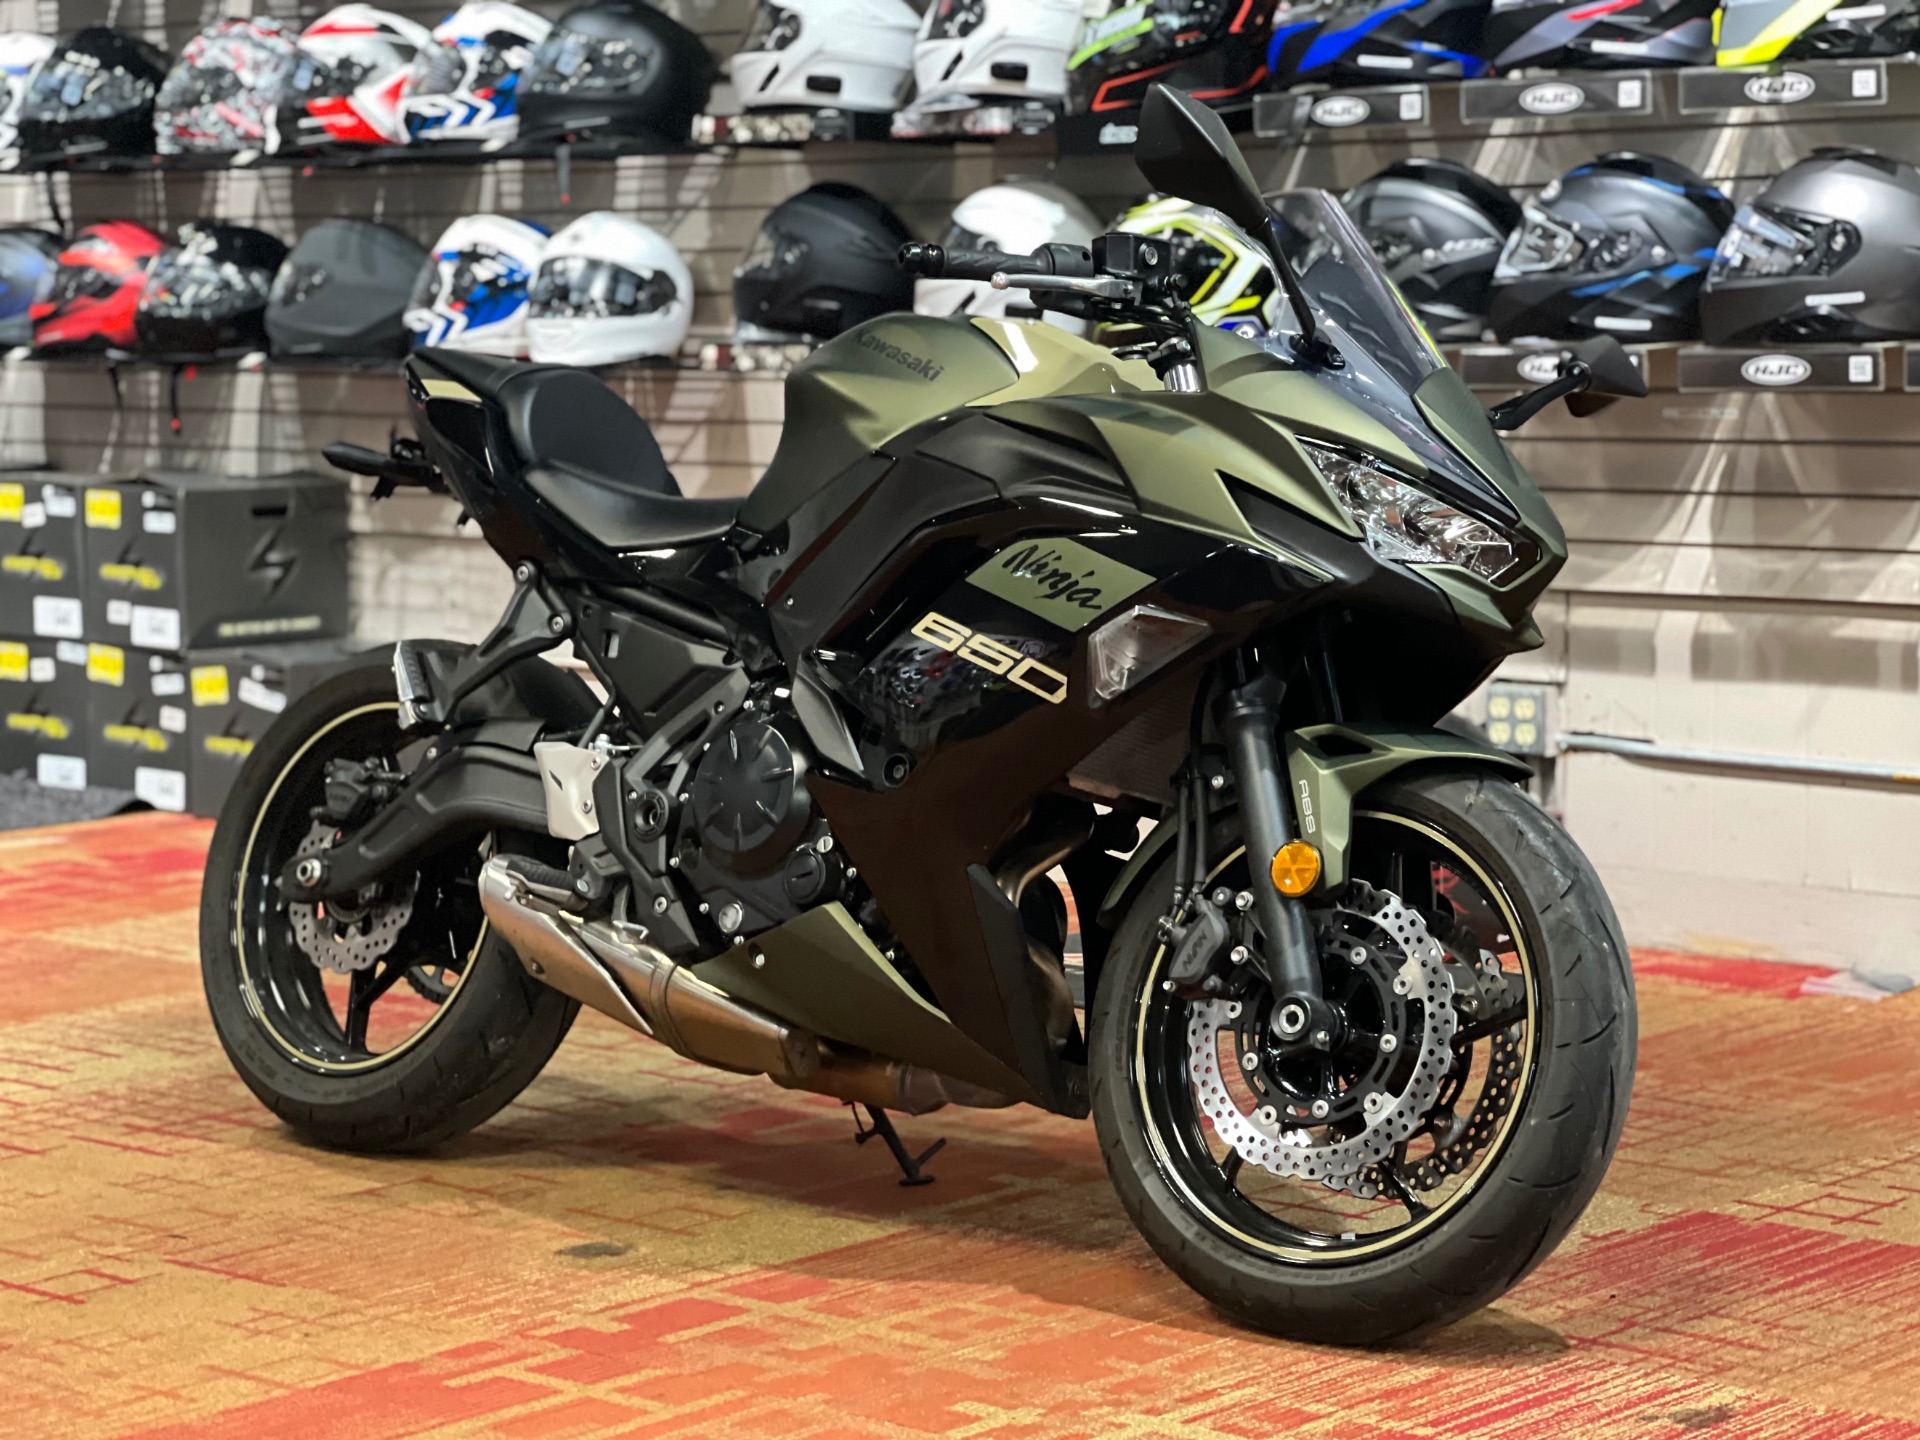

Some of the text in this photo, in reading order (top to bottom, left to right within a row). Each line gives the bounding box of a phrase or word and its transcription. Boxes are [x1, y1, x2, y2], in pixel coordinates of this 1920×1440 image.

[1758, 81, 1804, 94] HJC
[854, 329, 945, 382] Kawasaki
[1754, 364, 1799, 376] HJC
[1002, 544, 1102, 610] Ninja
[911, 611, 1068, 704] 650
[1299, 779, 1316, 834] ABS
